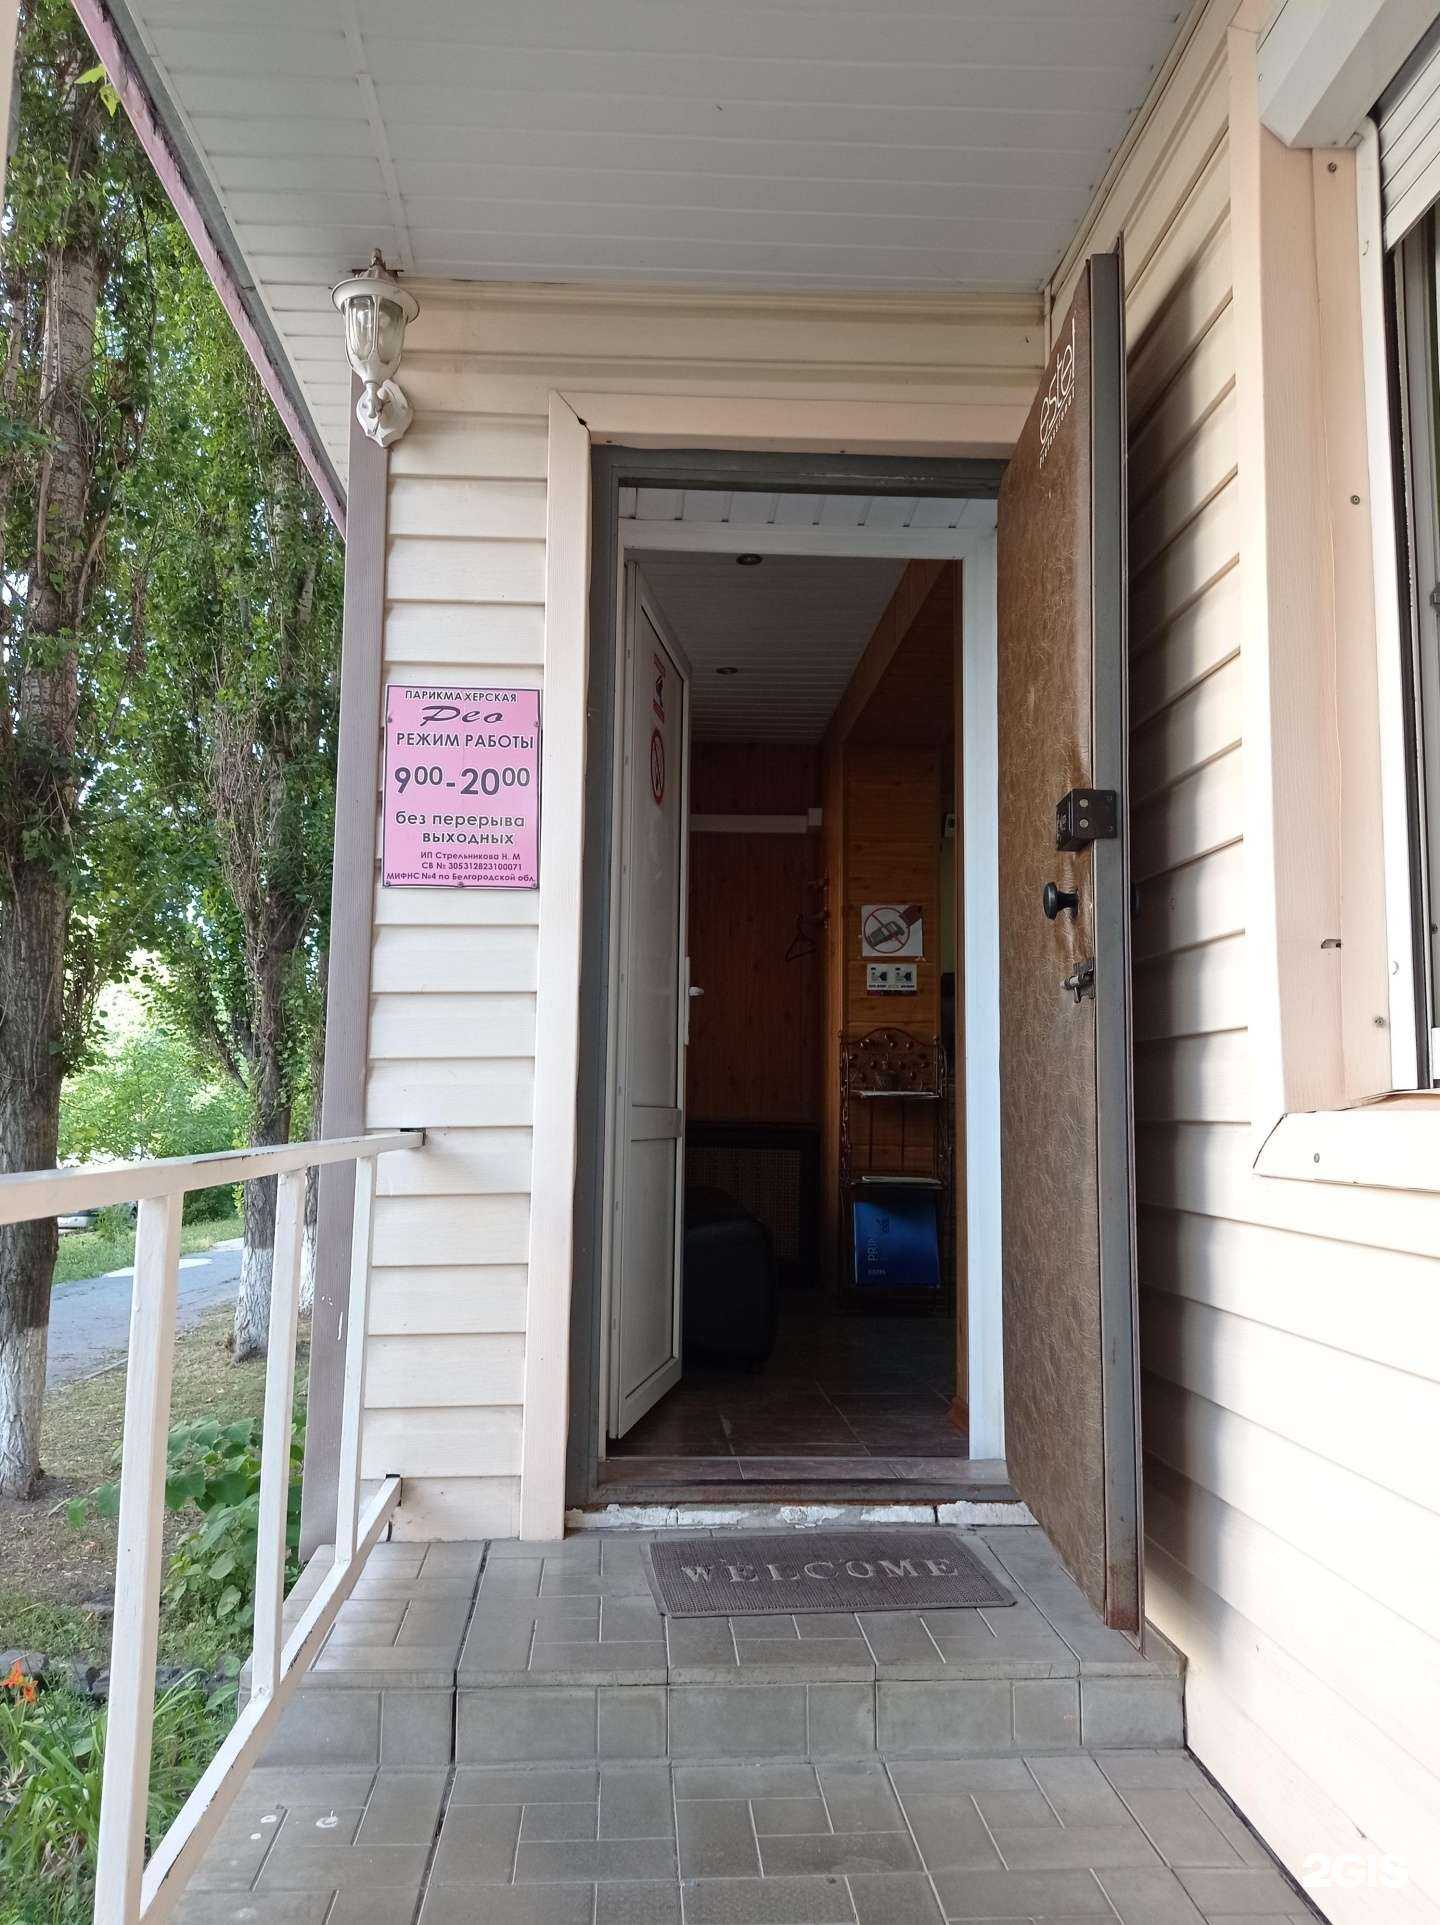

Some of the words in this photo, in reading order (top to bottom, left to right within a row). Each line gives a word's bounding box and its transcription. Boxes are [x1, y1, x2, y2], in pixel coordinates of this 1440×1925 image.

[1040, 317, 1076, 445] estel
[405, 690, 517, 703] ПАРИКМАХЕРСКАЯ
[396, 733, 459, 747] РЕЖИМ
[465, 735, 534, 749] РАБОТЫ
[396, 811, 425, 825] без
[432, 814, 525, 829] перерыва
[421, 851, 432, 859] ИП
[435, 851, 499, 861] Стрельникова
[387, 872, 419, 880] МИФНС
[452, 872, 516, 882] Белгородской
[681, 1557, 957, 1583] WELCOME
